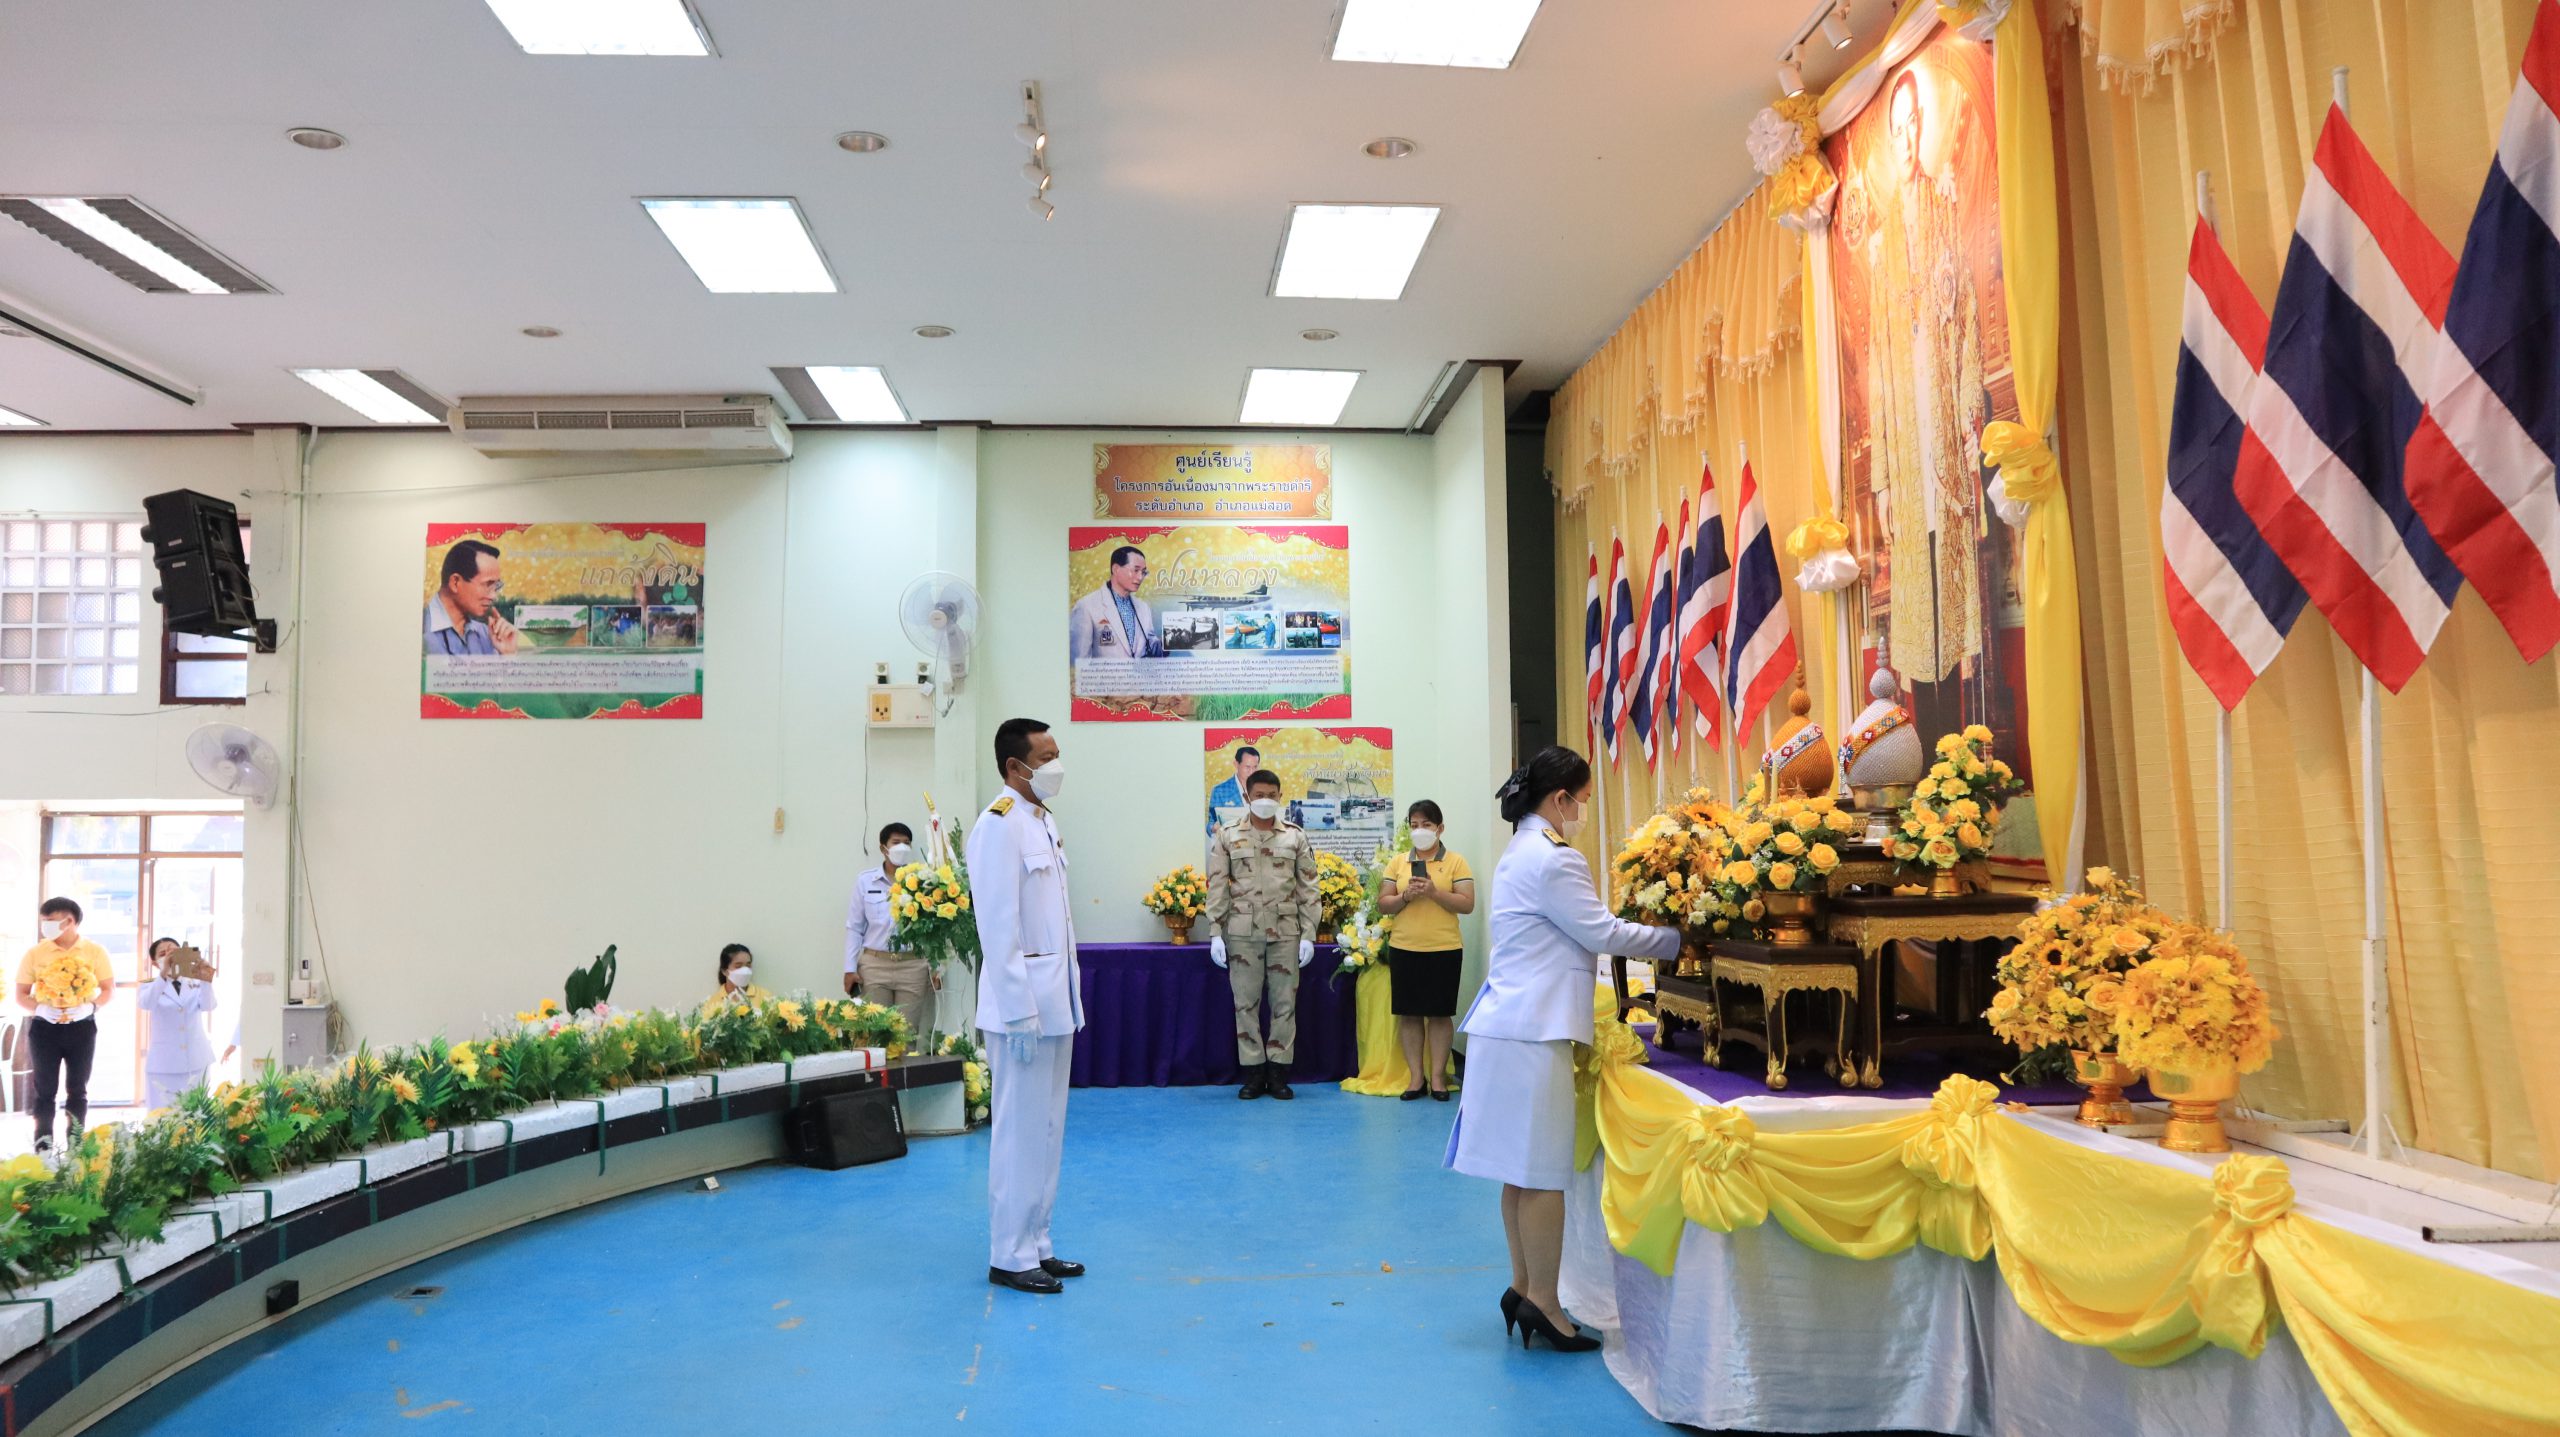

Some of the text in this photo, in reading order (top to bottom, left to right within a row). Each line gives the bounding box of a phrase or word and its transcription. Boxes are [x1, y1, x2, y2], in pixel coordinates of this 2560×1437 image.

[1175, 450, 1252, 474] ศูนย์เรียนรู้
[1114, 476, 1312, 493] โครงการอันเนื่องมาจากพระราชดำริ
[1135, 498, 1292, 512] ระดับอำเภอ อำเภอแม่สอด
[579, 542, 700, 587] แกล้งดิน
[1156, 548, 1280, 588] ฝนหลวง
